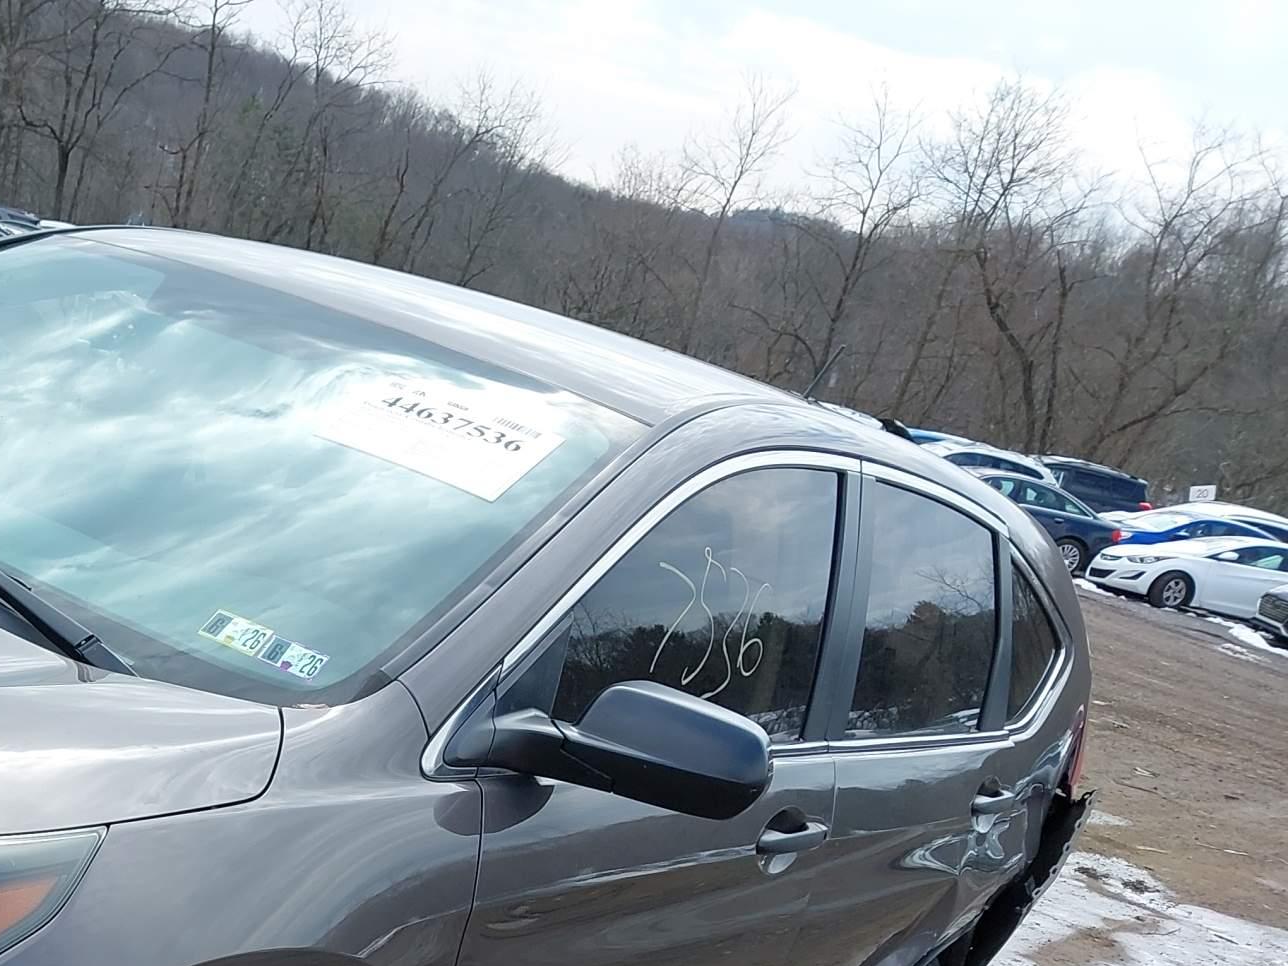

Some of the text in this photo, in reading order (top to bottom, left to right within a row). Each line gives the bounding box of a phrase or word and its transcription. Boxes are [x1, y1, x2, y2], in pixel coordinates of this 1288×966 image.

[381, 396, 526, 452] 44637536
[241, 629, 267, 650] 26
[649, 547, 773, 700] 7536
[298, 655, 324, 677] 26
